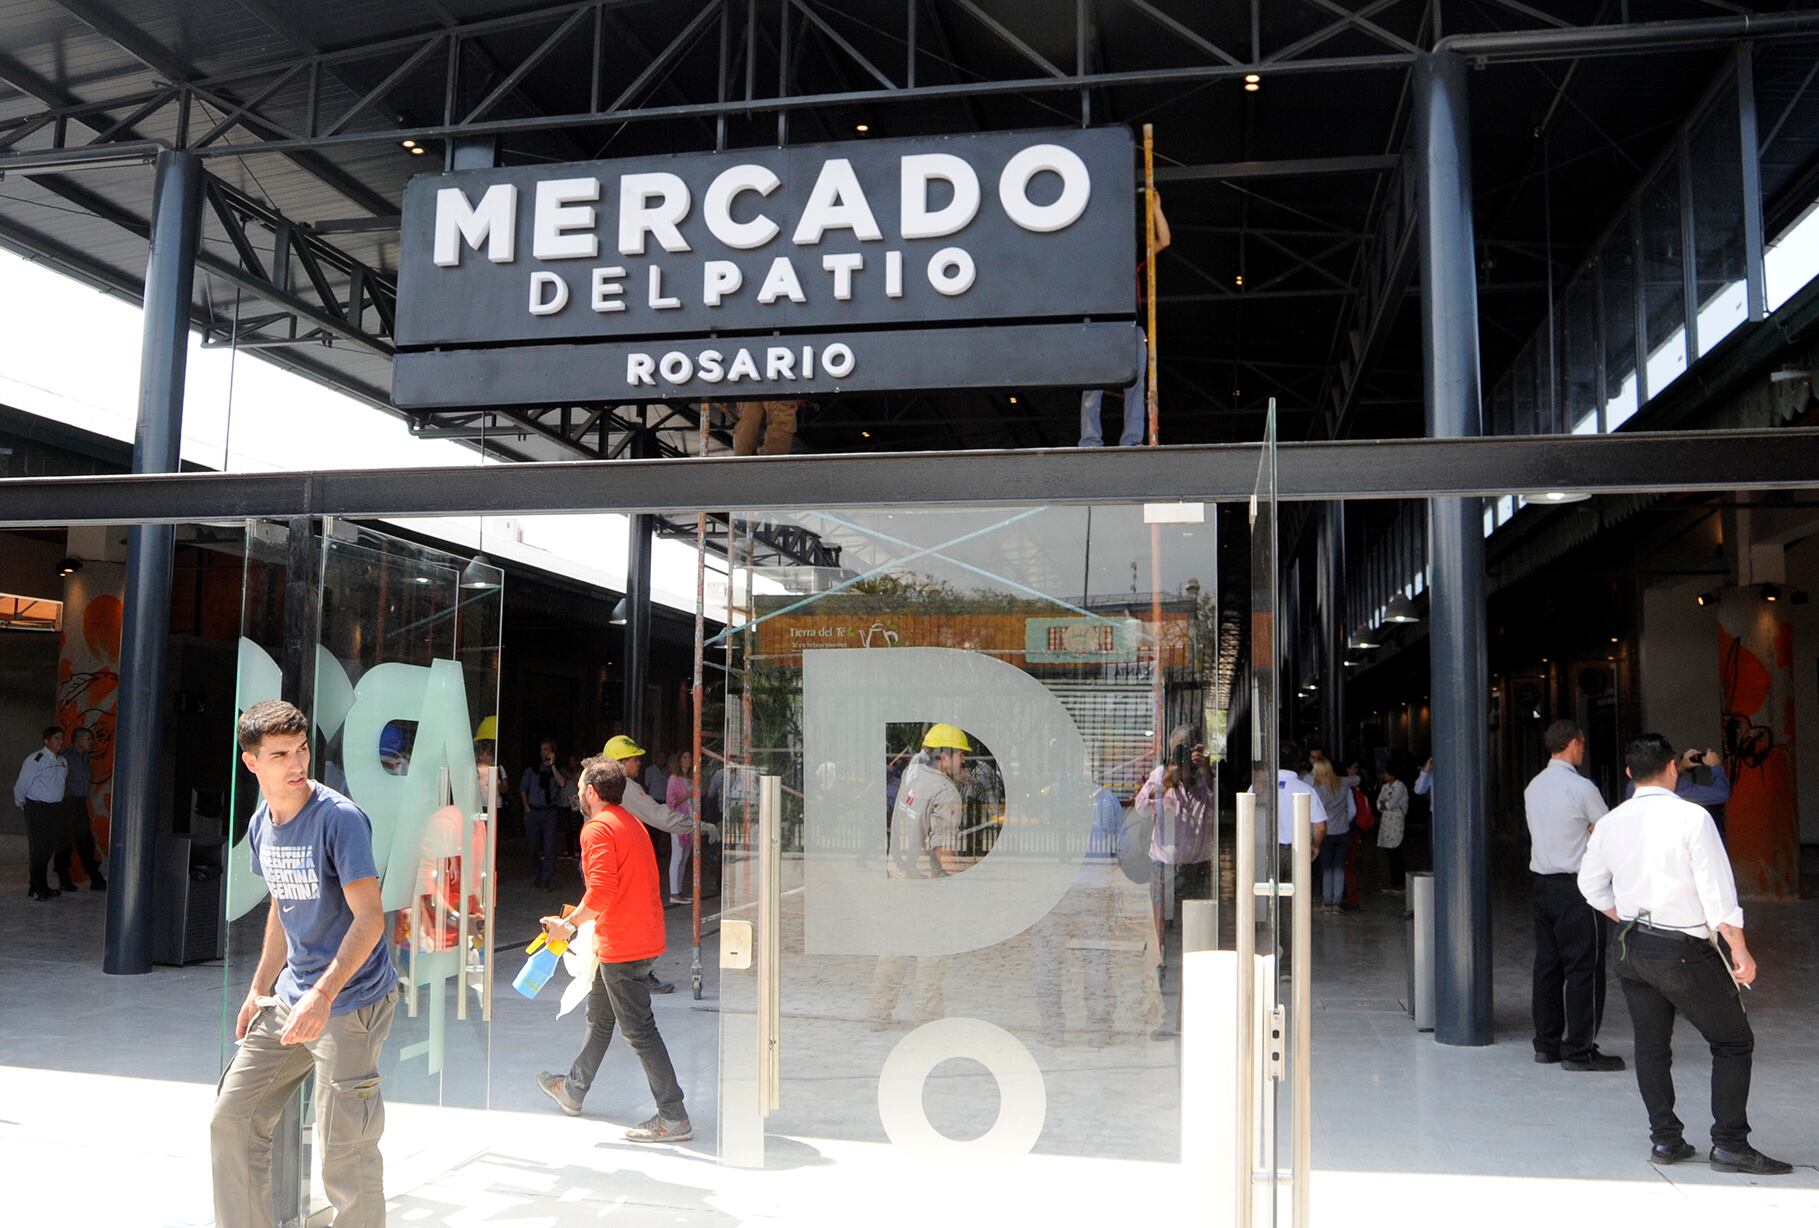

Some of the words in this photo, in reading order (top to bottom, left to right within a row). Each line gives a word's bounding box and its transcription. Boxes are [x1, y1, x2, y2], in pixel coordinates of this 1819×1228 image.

[432, 143, 1092, 268] MERCADO
[529, 264, 682, 316] DEL
[703, 246, 977, 306] PATIO
[626, 342, 856, 386] ROSARIO
[789, 627, 816, 637] Tierra
[818, 627, 833, 637] del
